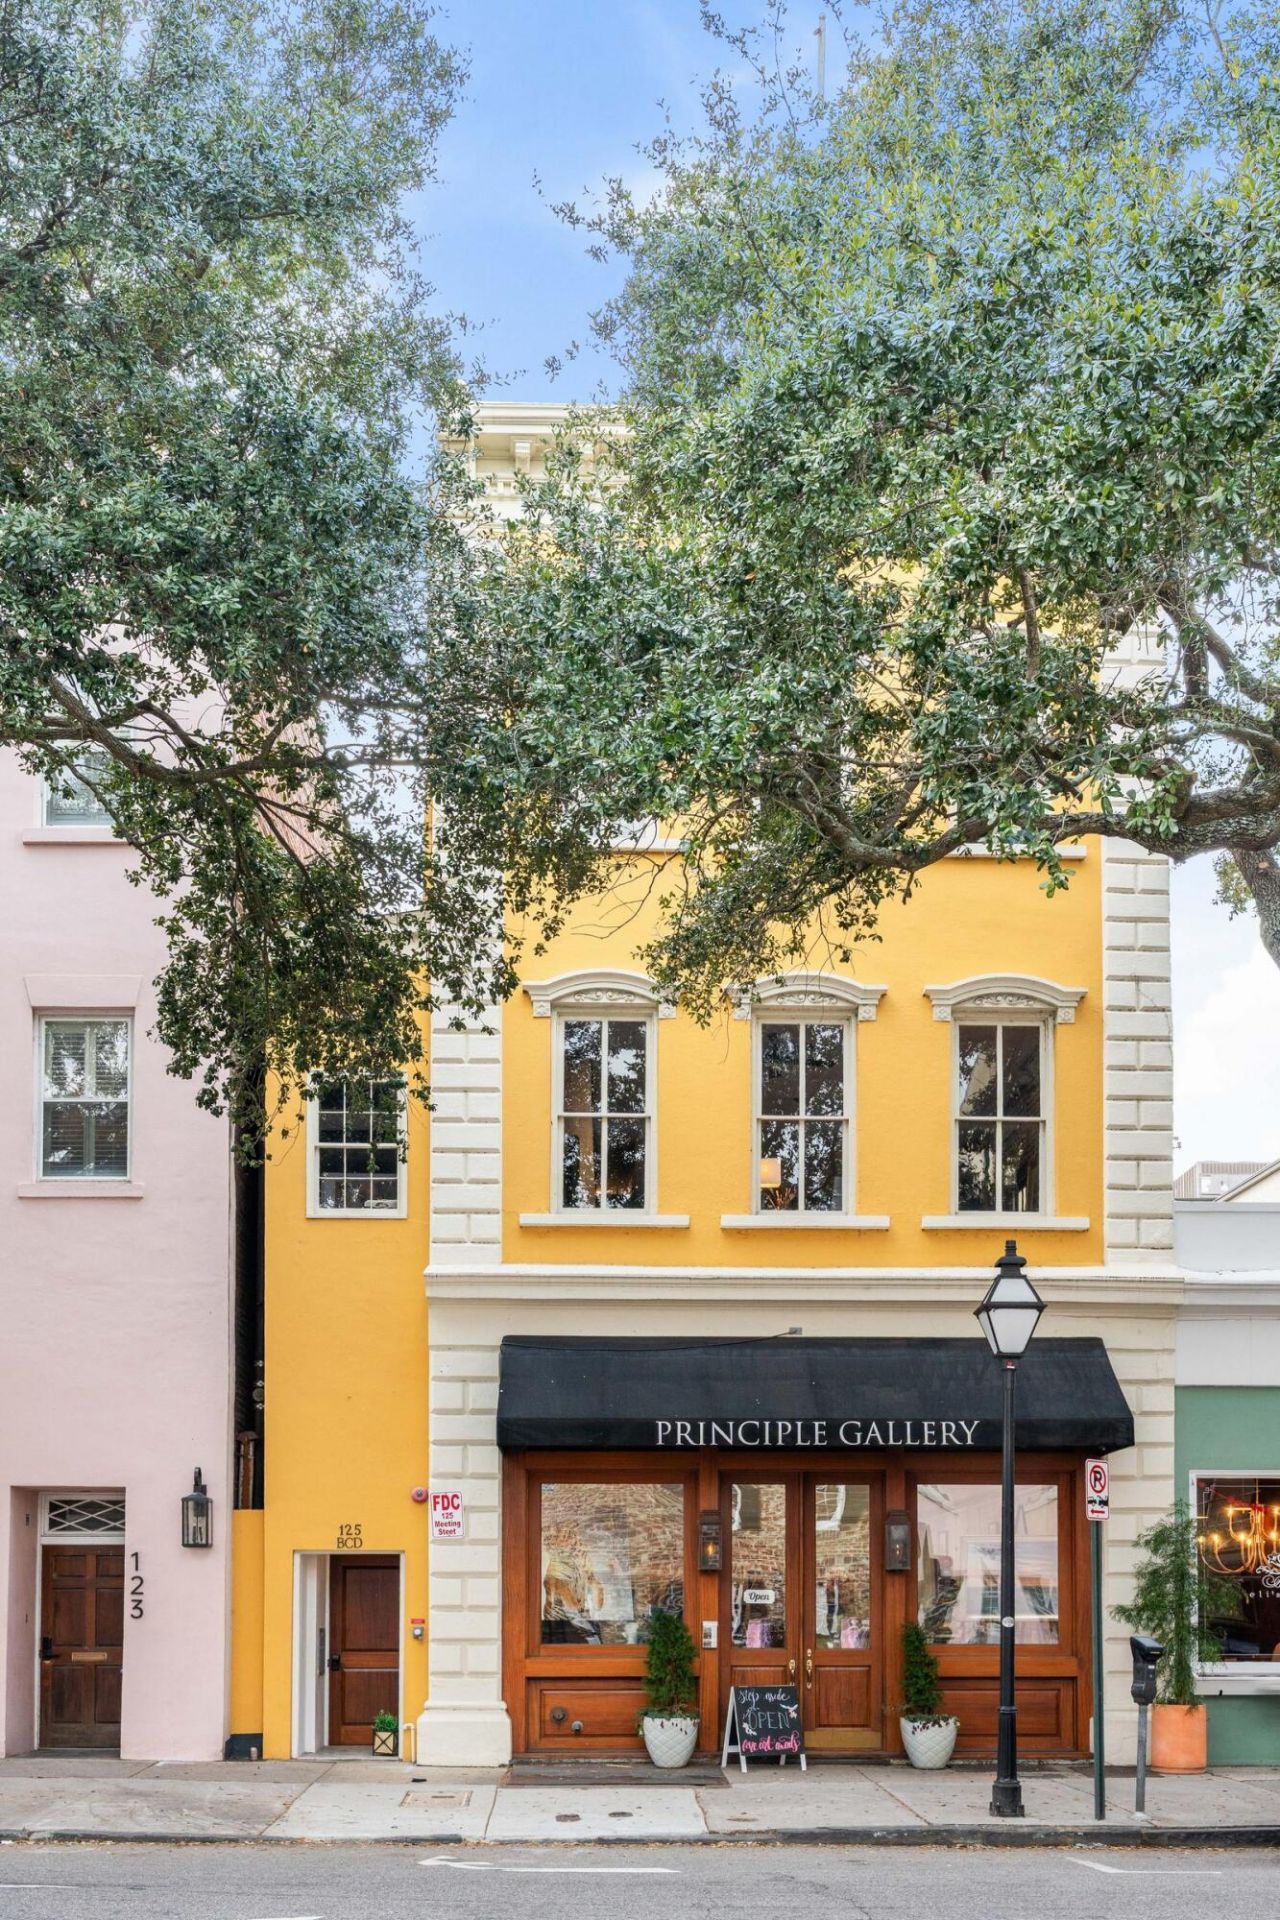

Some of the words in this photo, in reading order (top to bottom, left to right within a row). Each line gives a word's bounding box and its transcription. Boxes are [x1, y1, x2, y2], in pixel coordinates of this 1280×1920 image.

[655, 1420, 828, 1446] PRINCIPLE
[839, 1420, 980, 1446] GALLERY
[432, 1494, 460, 1511] FDC
[339, 1524, 361, 1536] 125
[434, 1520, 461, 1528] Meeting
[336, 1536, 363, 1549] BCD
[130, 1551, 145, 1619] 123
[749, 1592, 770, 1602] Open
[748, 1711, 790, 1729] OPEN
